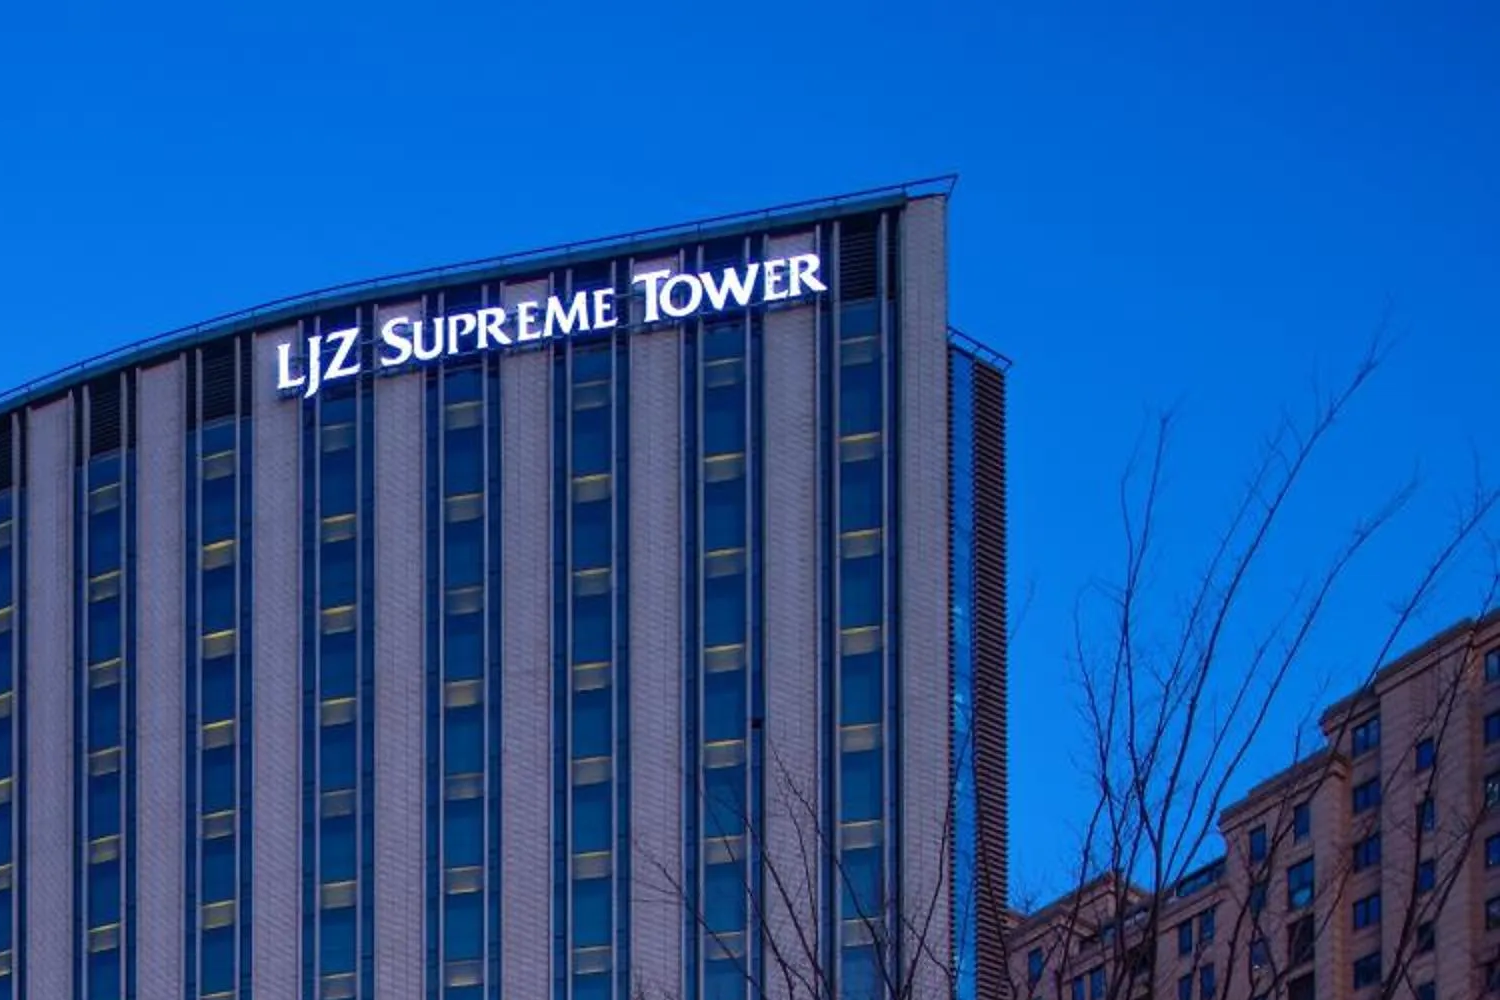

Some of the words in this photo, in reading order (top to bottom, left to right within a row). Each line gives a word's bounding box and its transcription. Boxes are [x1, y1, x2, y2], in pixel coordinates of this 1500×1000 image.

[277, 327, 360, 397] LJZ
[381, 287, 618, 366] SUPREME
[633, 253, 827, 322] TOWER
